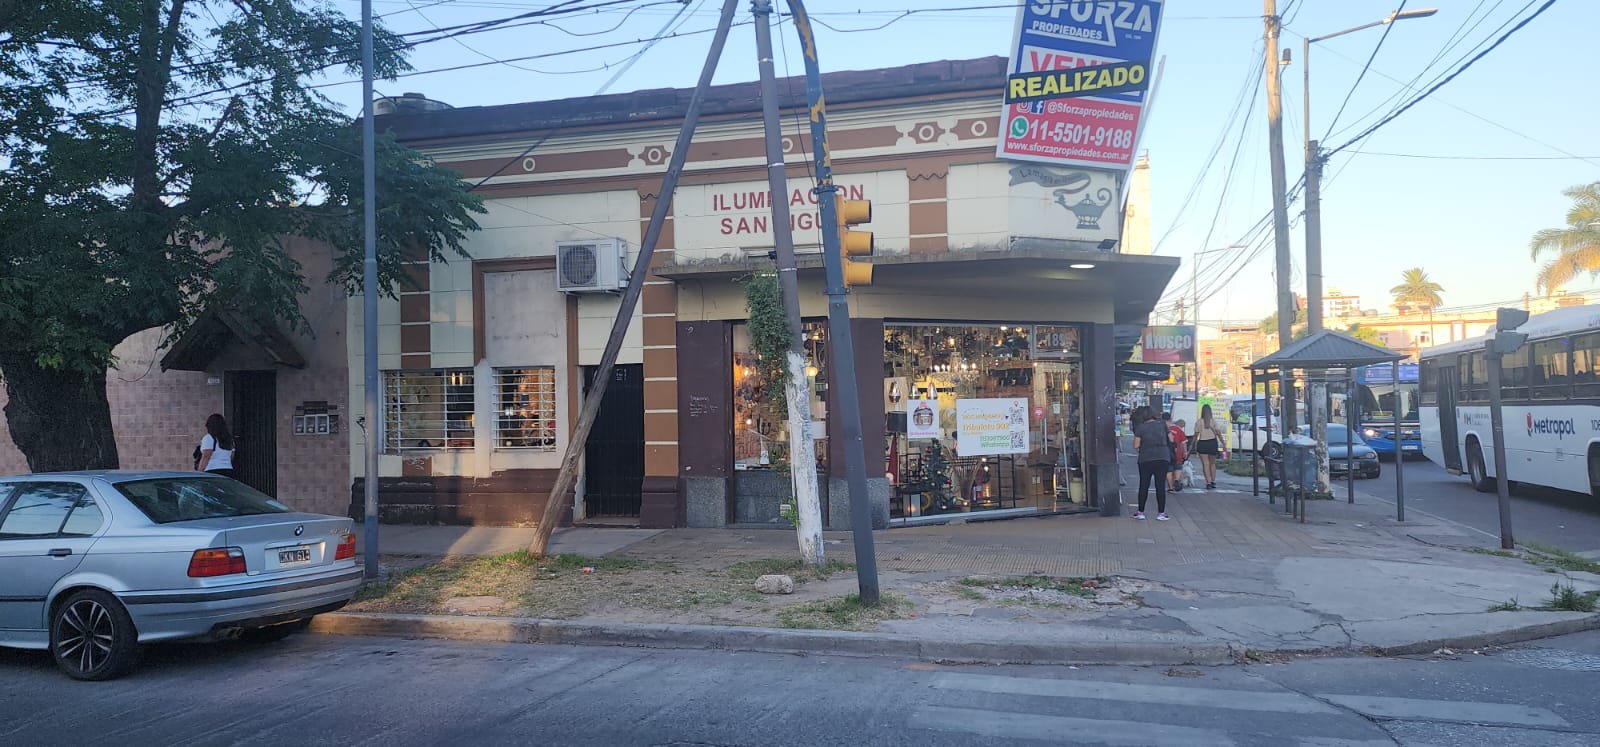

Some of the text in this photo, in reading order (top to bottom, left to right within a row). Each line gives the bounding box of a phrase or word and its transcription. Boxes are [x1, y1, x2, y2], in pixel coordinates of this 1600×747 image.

[1030, 0, 1152, 34] SFORZA
[1032, 20, 1103, 40] PROPIEDADES
[1009, 64, 1145, 98] REALIZADO
[1047, 101, 1134, 121] @Sforzapropiedades
[1030, 119, 1133, 149] 11-5501-9188
[1007, 141, 1130, 160] www.sforzapropiedades.com.ar
[720, 216, 767, 235] SAN
[1533, 416, 1576, 440] Metropol
